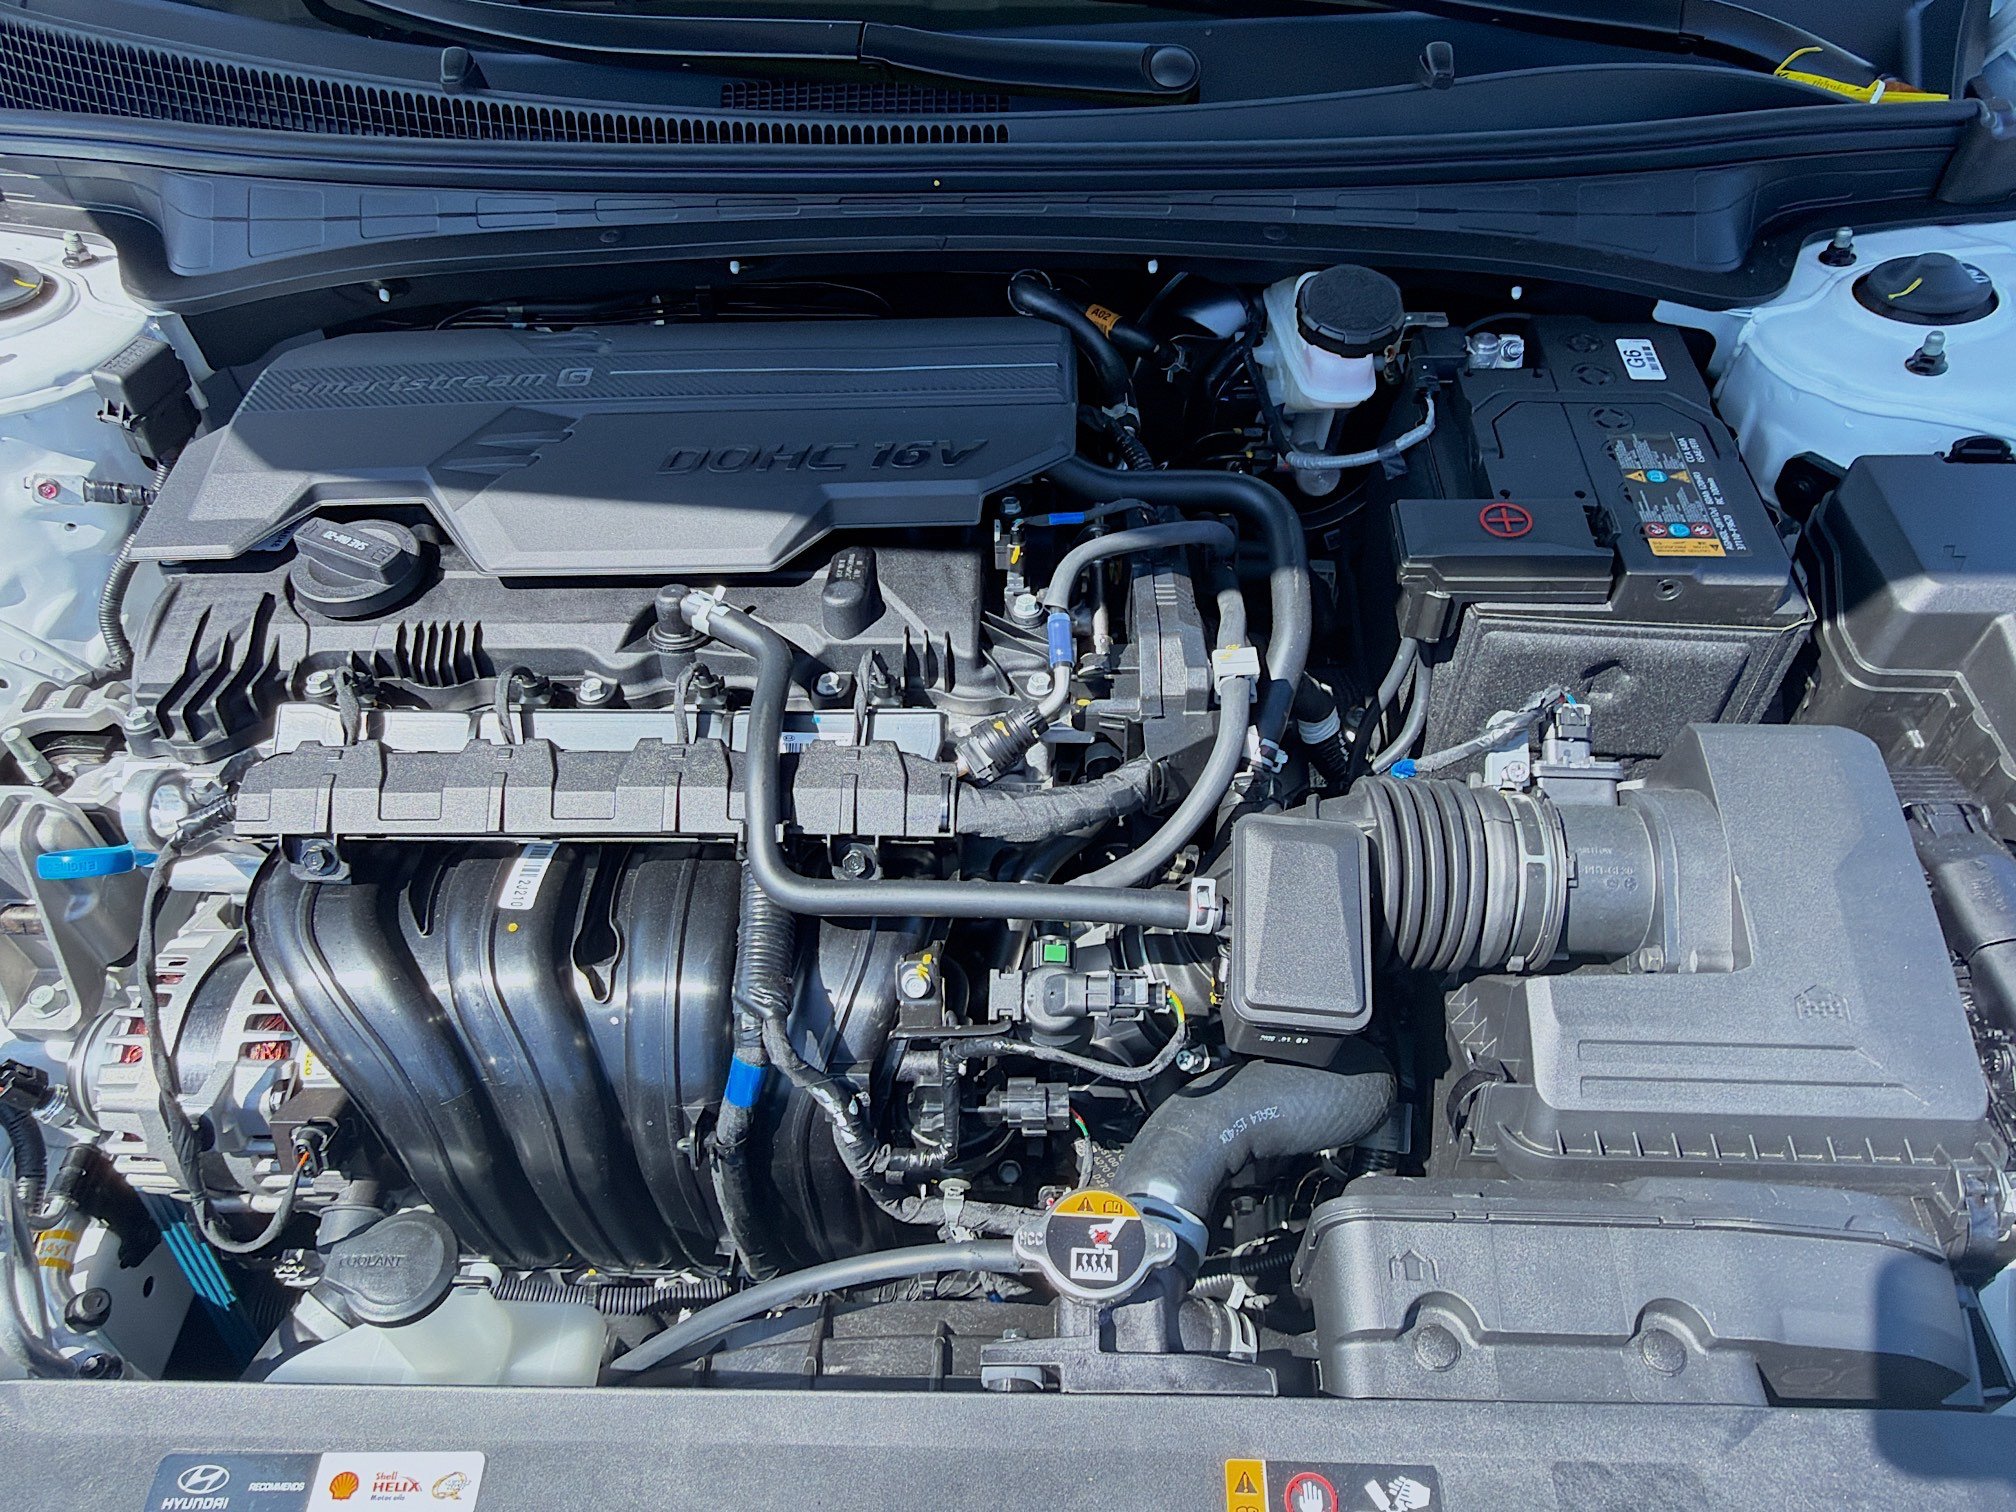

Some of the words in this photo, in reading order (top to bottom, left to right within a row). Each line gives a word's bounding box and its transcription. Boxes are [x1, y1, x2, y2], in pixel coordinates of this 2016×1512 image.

[1623, 349, 1646, 368] G6
[655, 443, 857, 475] DOHC
[870, 438, 989, 470] 16V
[346, 538, 370, 551] SAE
[1018, 1230, 1044, 1246] HCC
[1153, 1232, 1172, 1249] 1.1
[338, 1253, 407, 1268] COOLANT
[375, 1471, 398, 1481] Shell
[160, 1497, 230, 1511] HYUNDAI
[247, 1482, 306, 1492] RECOMMENDS
[372, 1481, 421, 1493] HELIX
